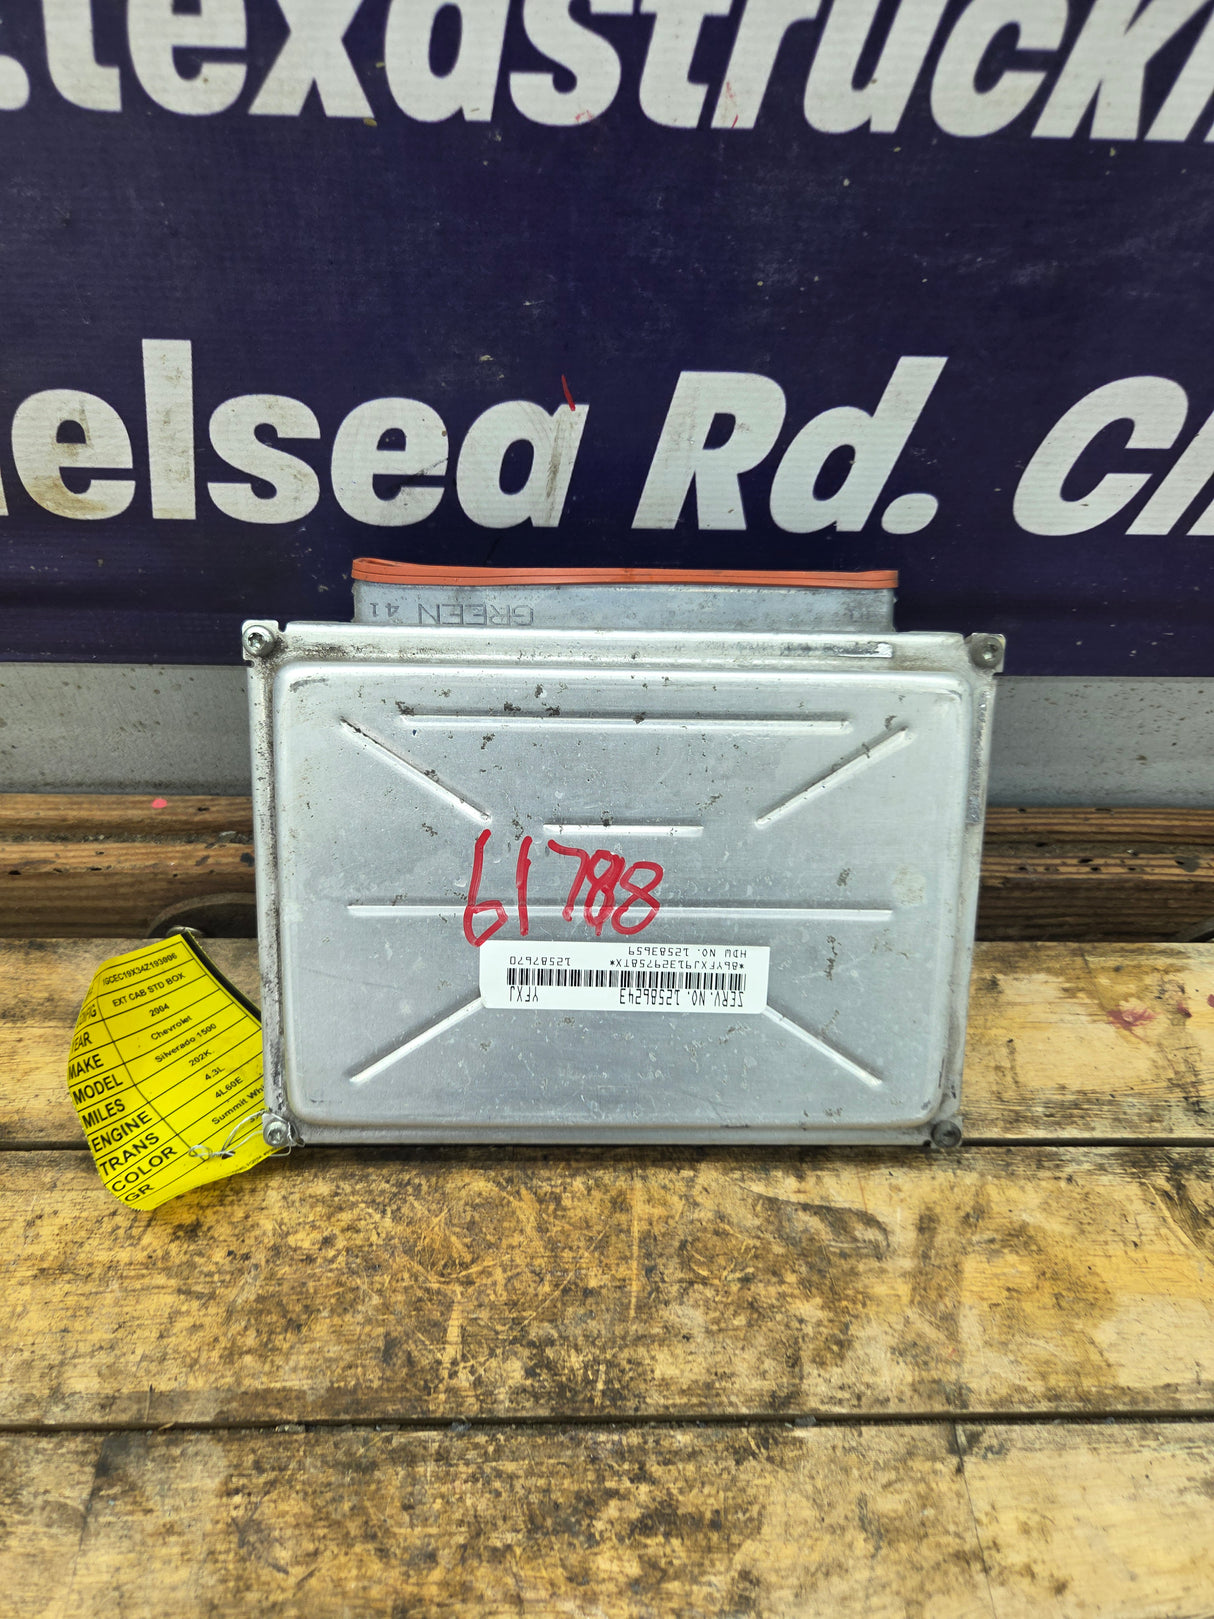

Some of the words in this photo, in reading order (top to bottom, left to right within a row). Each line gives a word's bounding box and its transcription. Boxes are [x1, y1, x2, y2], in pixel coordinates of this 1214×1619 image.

[0, 339, 589, 529] elsea
[632, 357, 948, 534] Rd.
[370, 602, 400, 618] 41
[418, 603, 533, 626] GREEN
[463, 828, 663, 947] 61788
[509, 956, 571, 967] 12587670
[628, 946, 689, 957] 12583659
[112, 996, 127, 1008] EXT
[128, 988, 147, 1001] CAB
[147, 982, 165, 993] STD
[165, 972, 186, 985] BOX
[509, 986, 539, 1002] YFXJ
[619, 988, 681, 1005] 12586243
[149, 1003, 170, 1017] 2004
[68, 1053, 104, 1080] MAKE
[151, 1015, 193, 1041] Chevrolet
[72, 1074, 123, 1105] MODEL
[154, 1036, 196, 1063] Silverado
[196, 1023, 217, 1038] 1500
[82, 1098, 126, 1130] MILES
[188, 1049, 212, 1067] 202K
[91, 1110, 152, 1153] ENGINE
[204, 1066, 225, 1081] 4.3L
[99, 1132, 159, 1177] TRANS
[215, 1076, 243, 1099] 4L60E
[111, 1146, 178, 1192] COLOR
[211, 1098, 248, 1125] Summit
[124, 1183, 155, 1202] GR
